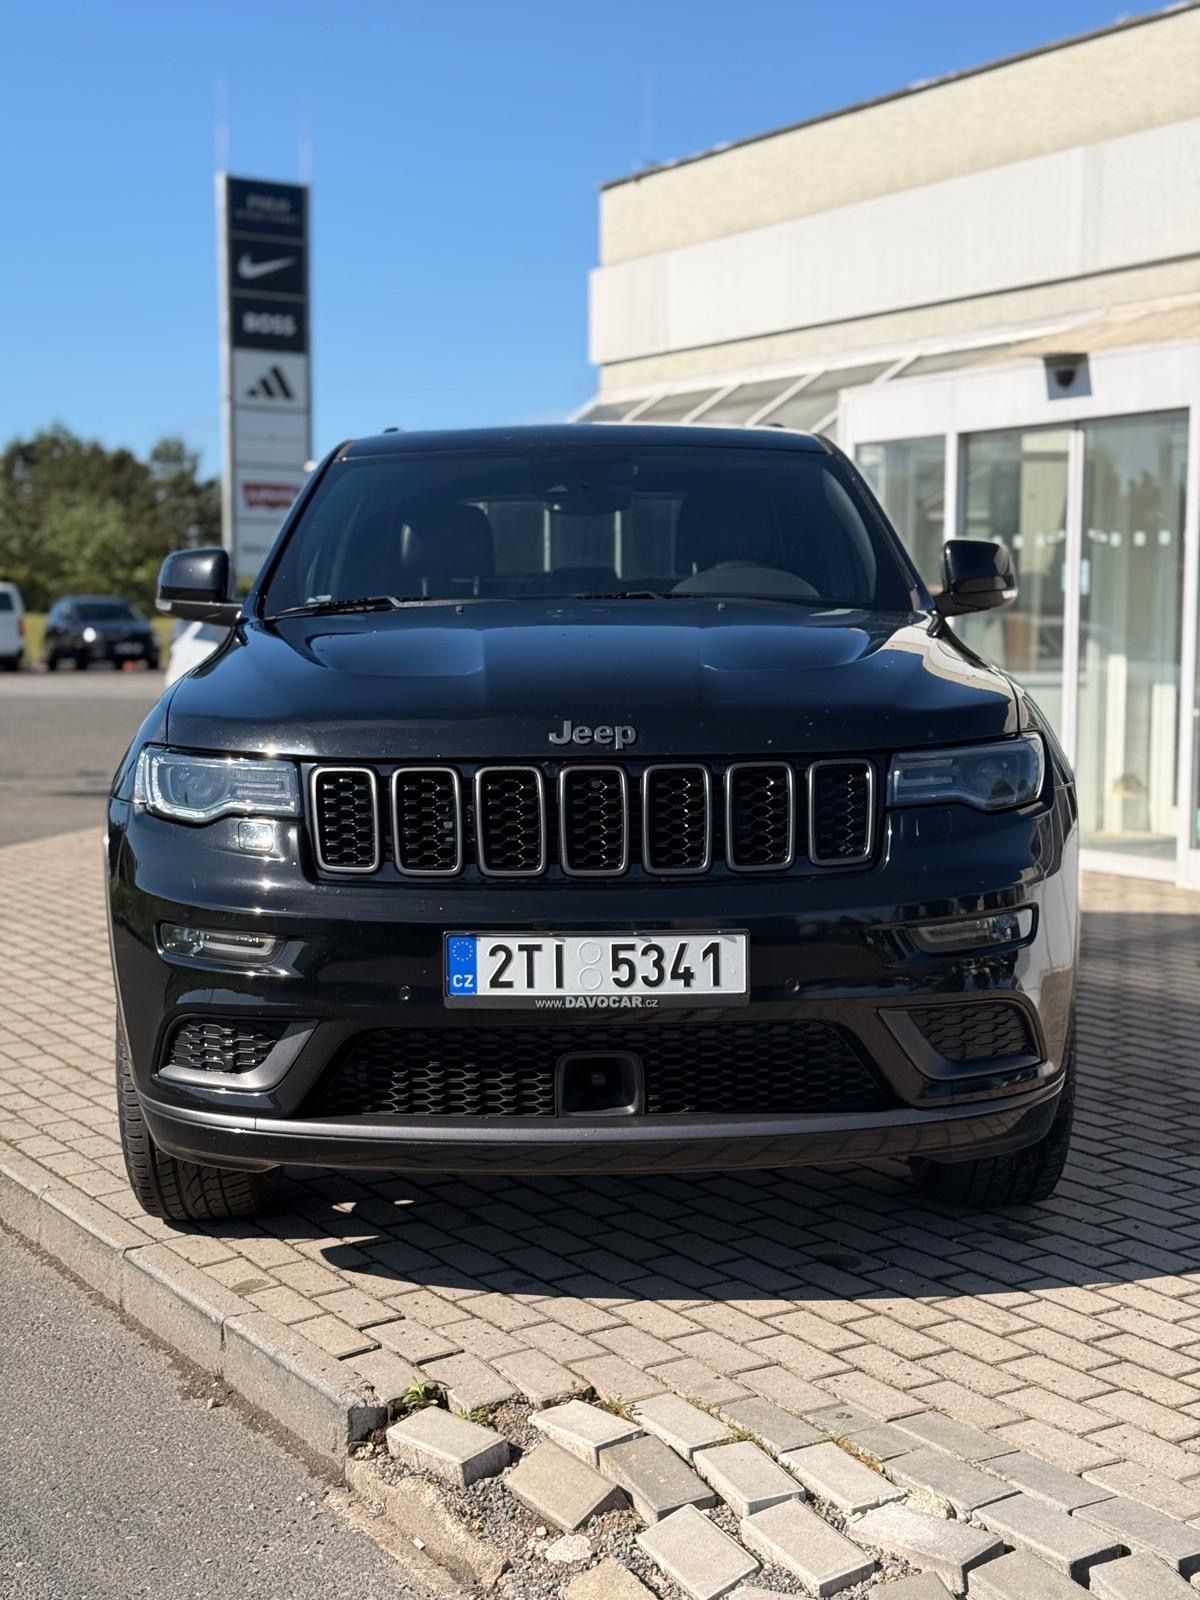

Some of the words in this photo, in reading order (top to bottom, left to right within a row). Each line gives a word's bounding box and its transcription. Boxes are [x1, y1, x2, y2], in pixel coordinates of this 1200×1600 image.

[548, 720, 637, 750] Jeep
[611, 942, 723, 988] 5341
[452, 974, 474, 988] CZ
[535, 996, 659, 1009] www.DAVOCAR.cz
